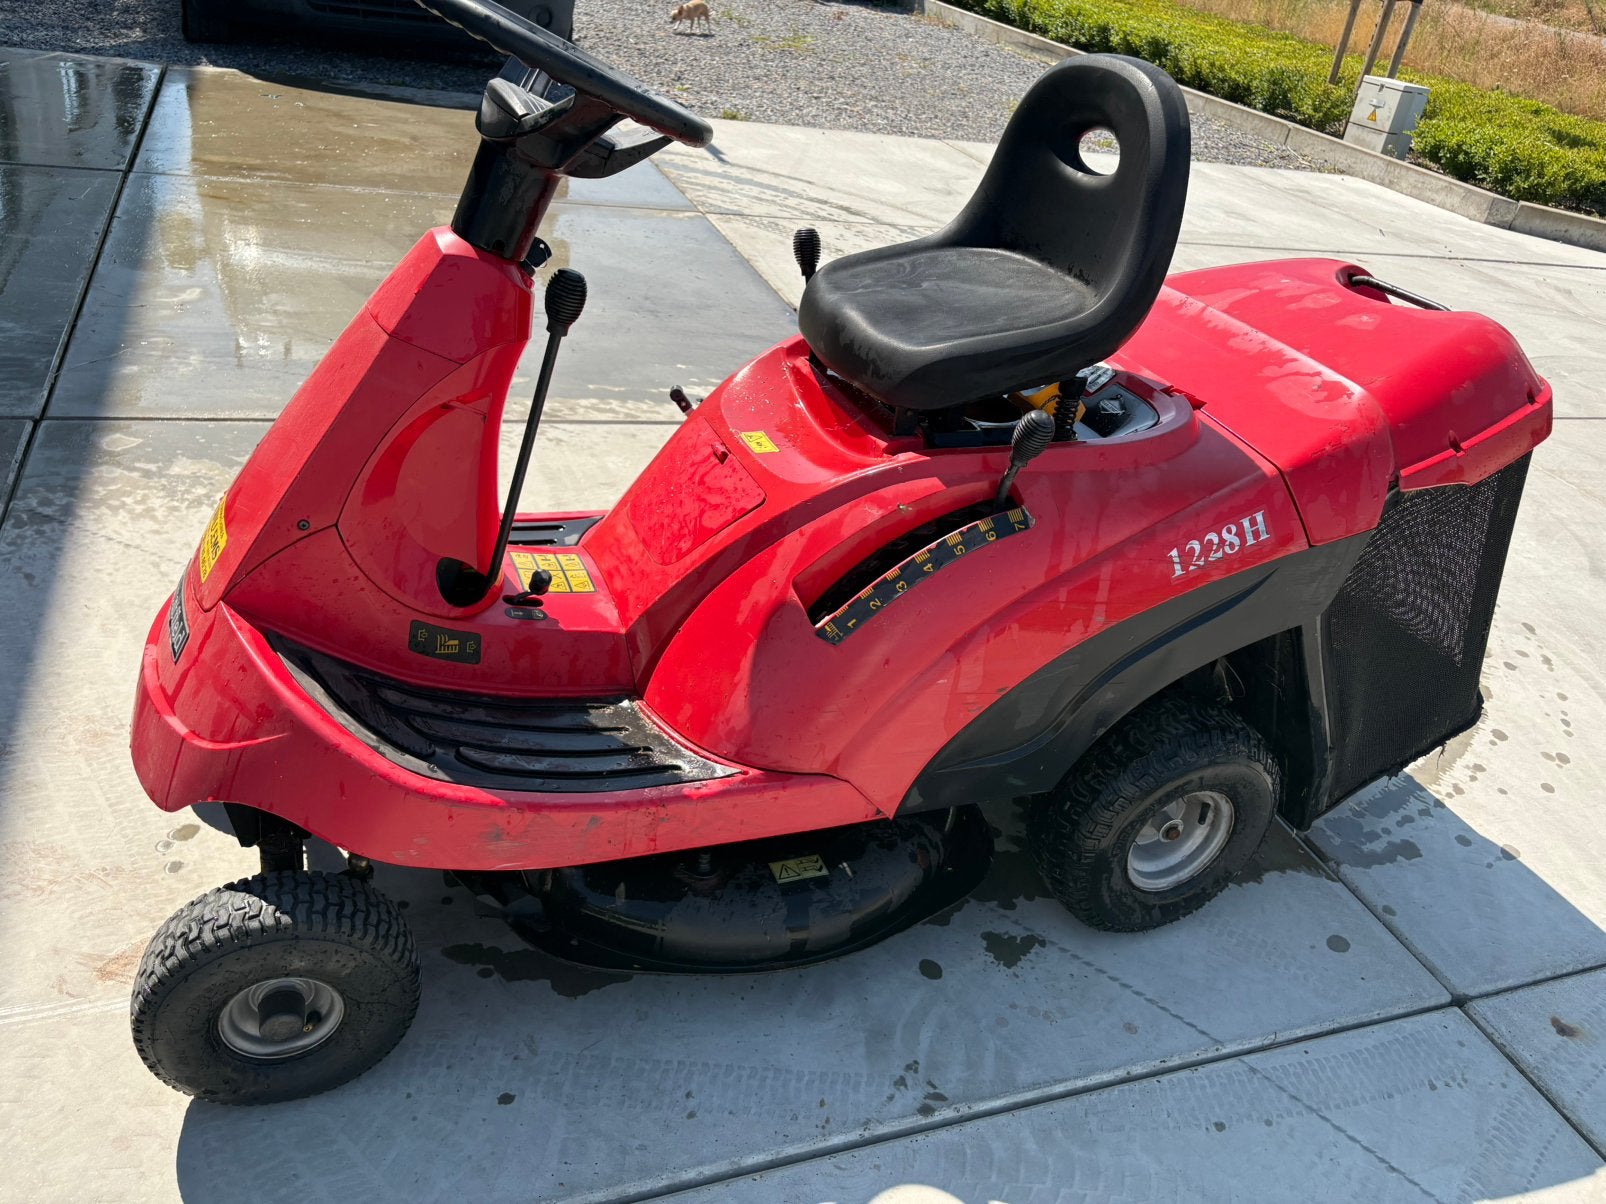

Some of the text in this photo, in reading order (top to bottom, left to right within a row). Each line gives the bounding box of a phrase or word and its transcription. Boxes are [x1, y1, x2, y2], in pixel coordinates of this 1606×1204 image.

[847, 522, 1026, 628] 1 2 3 4 5 6 7
[1167, 509, 1271, 578] 1228H
